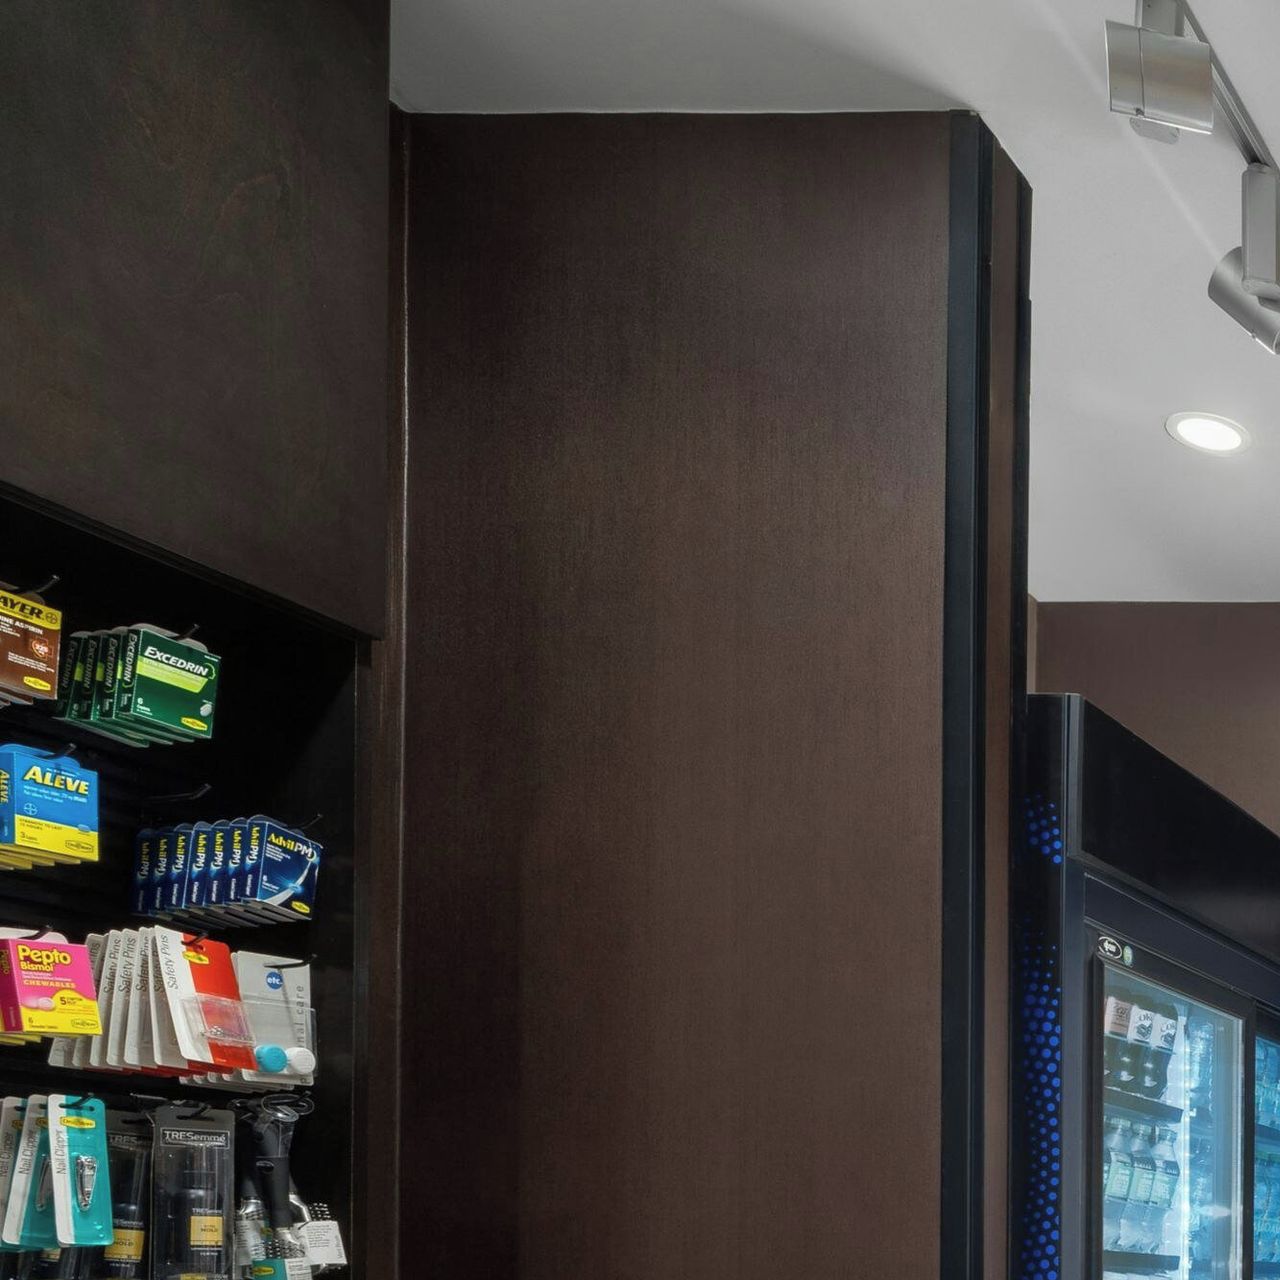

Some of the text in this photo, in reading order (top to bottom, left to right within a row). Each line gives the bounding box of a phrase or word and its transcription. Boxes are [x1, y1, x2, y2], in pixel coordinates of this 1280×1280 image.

[124, 633, 138, 682] EXCEDRIN
[144, 646, 209, 676] EXCEDRIN
[24, 765, 90, 795] ALEVE
[268, 833, 294, 851] Advil
[294, 842, 312, 857] PM
[17, 944, 72, 966] Pepto
[20, 961, 54, 972] Bismol
[104, 938, 121, 993] Safety Pins
[118, 938, 137, 993] Safety Pins
[161, 935, 179, 990] Safety Pins
[296, 985, 305, 1015] care
[164, 1131, 226, 1143] TRESemmé
